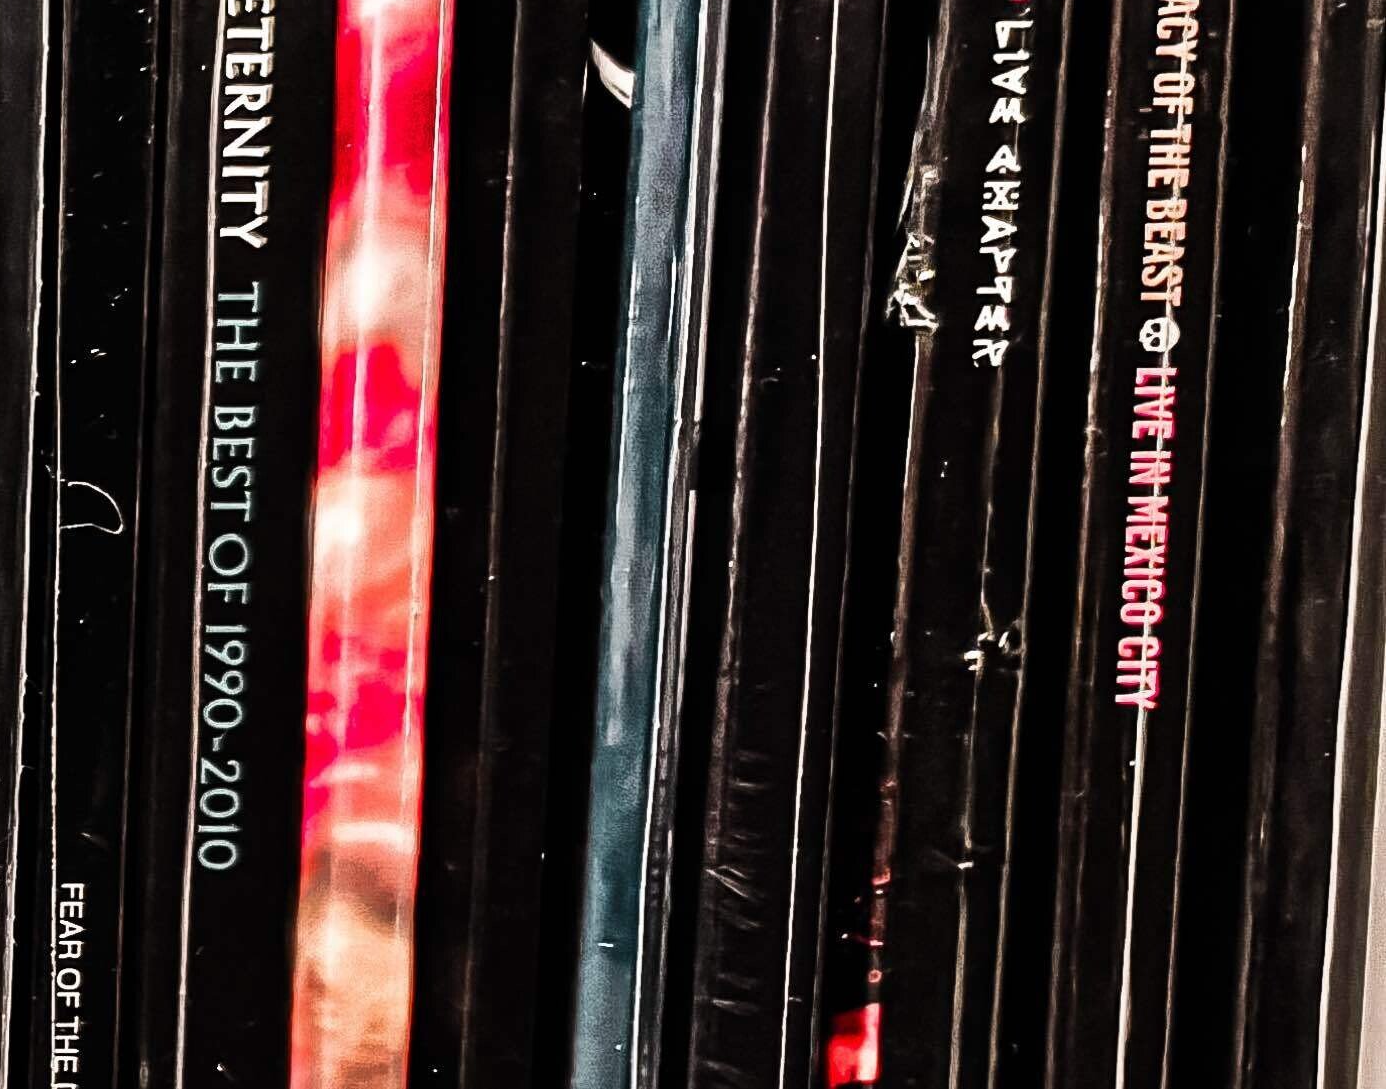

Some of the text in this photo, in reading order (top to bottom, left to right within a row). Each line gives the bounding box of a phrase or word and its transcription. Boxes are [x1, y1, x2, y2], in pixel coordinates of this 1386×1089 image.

[989, 20, 1033, 125] LIVE
[1153, 70, 1198, 117] OF
[1147, 123, 1192, 188] THE
[972, 144, 1021, 367] CHAPTER
[1139, 197, 1188, 307] BEAST
[214, 282, 266, 382] THE
[1131, 367, 1178, 440] LIVE
[210, 407, 258, 524] BEST
[1128, 450, 1173, 484] IN
[208, 534, 252, 607] OF
[1120, 496, 1168, 624] MEXICO
[1113, 636, 1163, 708] CITY
[196, 624, 248, 870] 1990-2010
[58, 882, 85, 959] FEAR
[56, 967, 82, 1008] OF
[53, 1015, 80, 1073] THE
